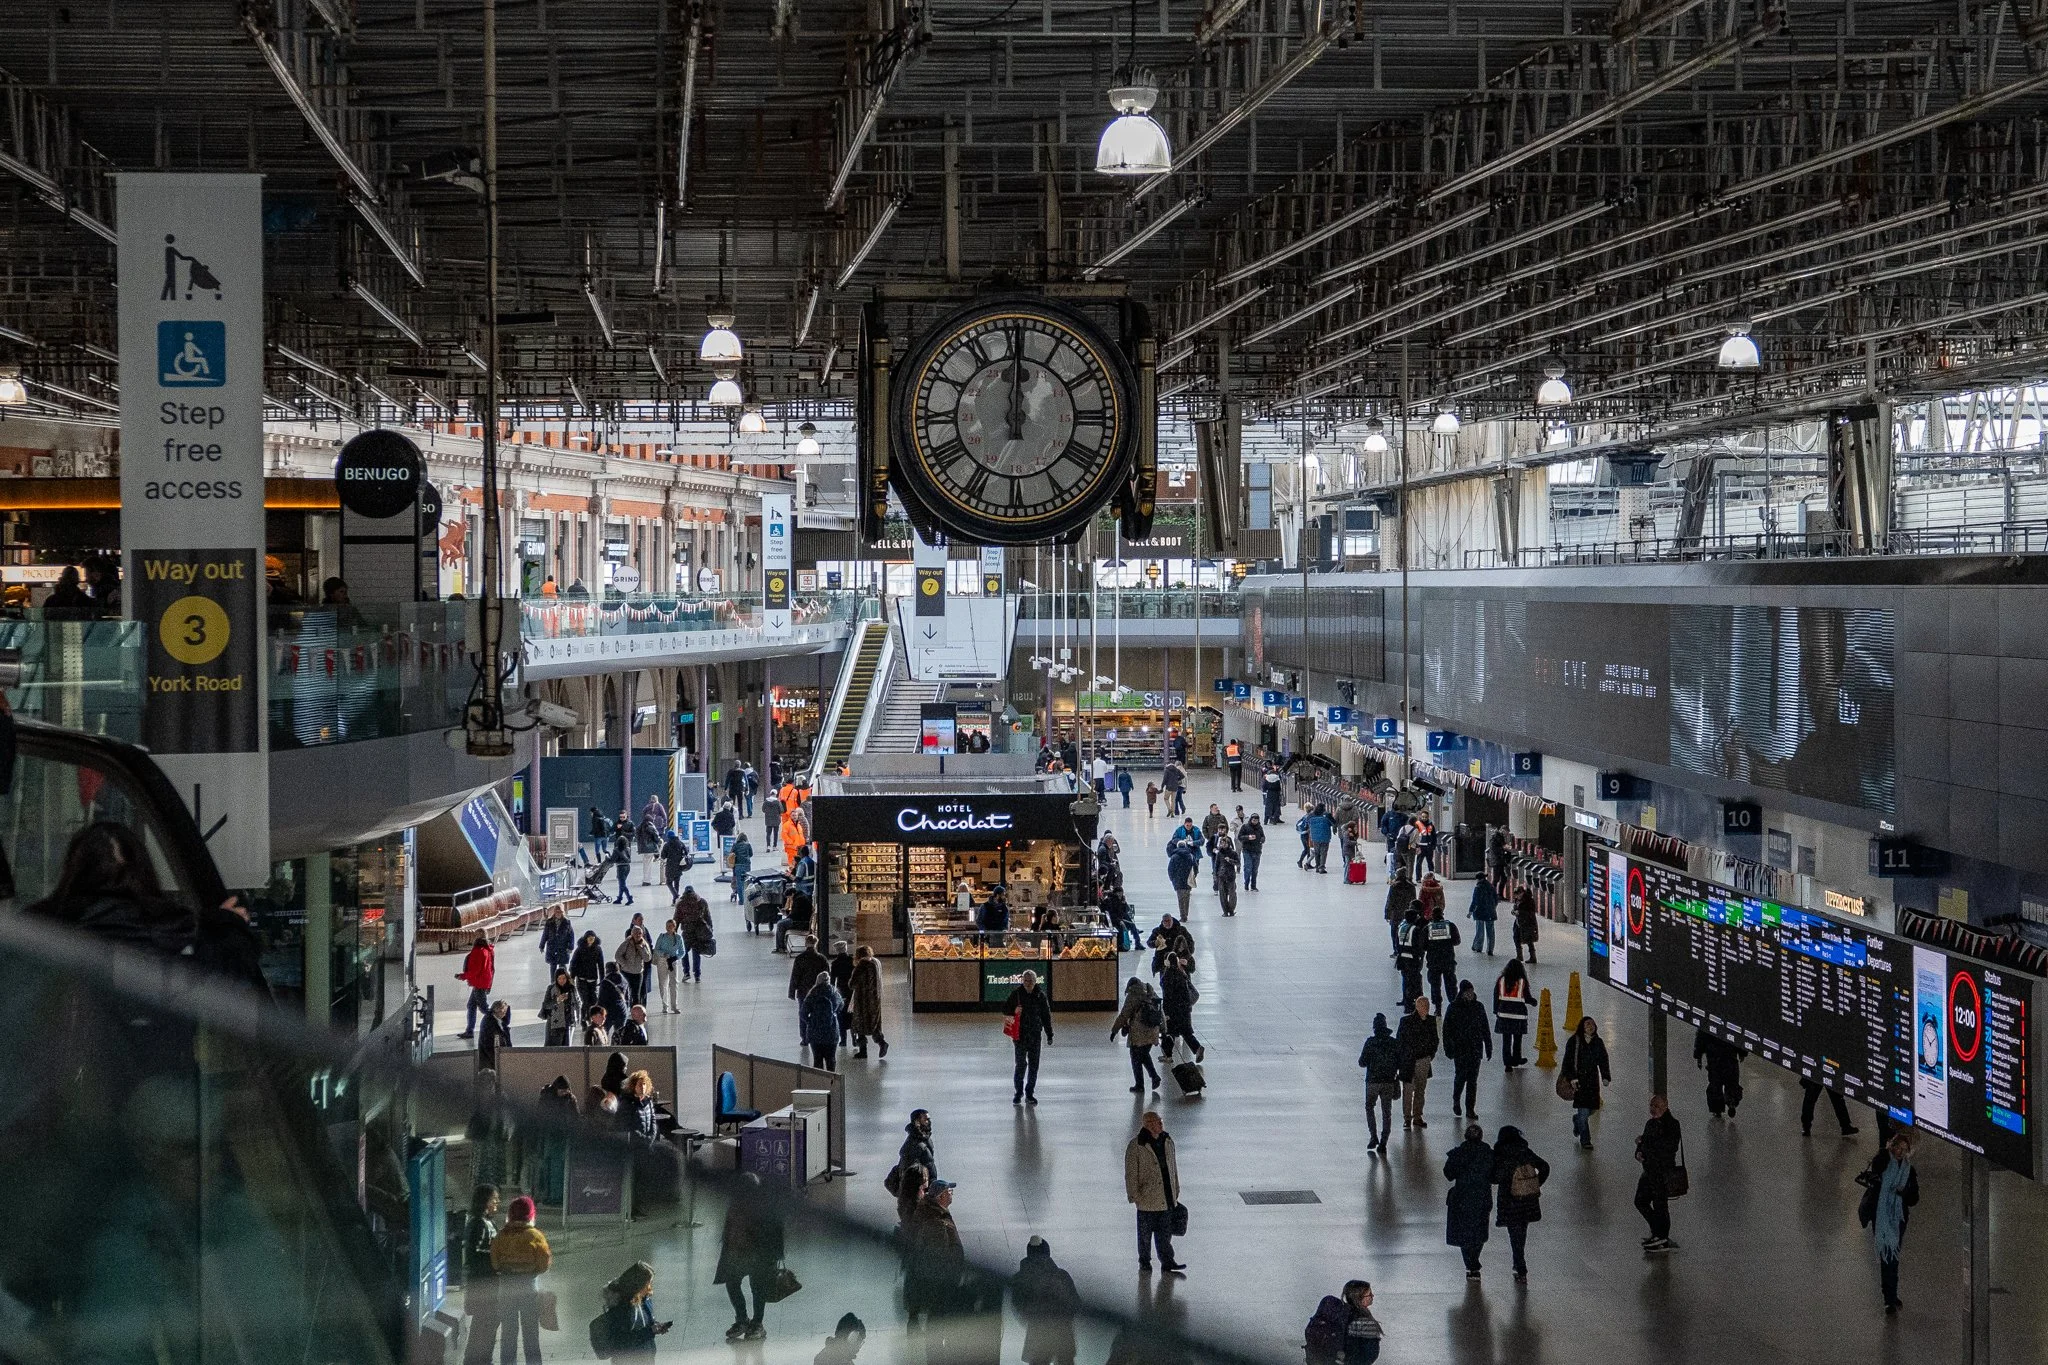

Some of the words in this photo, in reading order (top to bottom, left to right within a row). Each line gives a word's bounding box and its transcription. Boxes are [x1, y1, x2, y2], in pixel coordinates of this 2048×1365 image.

[160, 402, 225, 430] Step
[163, 438, 222, 462] free
[344, 467, 409, 481] BENUGO
[145, 480, 242, 500] access
[1160, 537, 1182, 546] BOOT
[527, 542, 545, 556] GRIND
[144, 560, 199, 584] Way
[204, 560, 244, 580] out
[918, 569, 933, 577] Way
[183, 615, 206, 646] 3
[149, 676, 191, 692] York
[196, 675, 243, 691] Road
[1218, 681, 1224, 689] 1
[1239, 686, 1246, 695] 2
[773, 699, 805, 708] LUSH
[1268, 693, 1275, 703] 3
[1296, 701, 1303, 710] 4
[1334, 710, 1341, 721] 5
[1381, 722, 1389, 733] 6
[1435, 736, 1444, 747] 7
[1522, 757, 1531, 771] 8
[1610, 779, 1620, 794] 9
[938, 805, 972, 813] HOTEL
[897, 808, 1013, 831] Chocolat.
[1728, 810, 1750, 828] 10
[1884, 850, 1910, 868] 11
[1866, 934, 1884, 951] Further
[1866, 953, 1892, 973] Departures
[987, 975, 1009, 984] Taste
[1984, 970, 2001, 986] Status
[1954, 1005, 1976, 1029] 12:00
